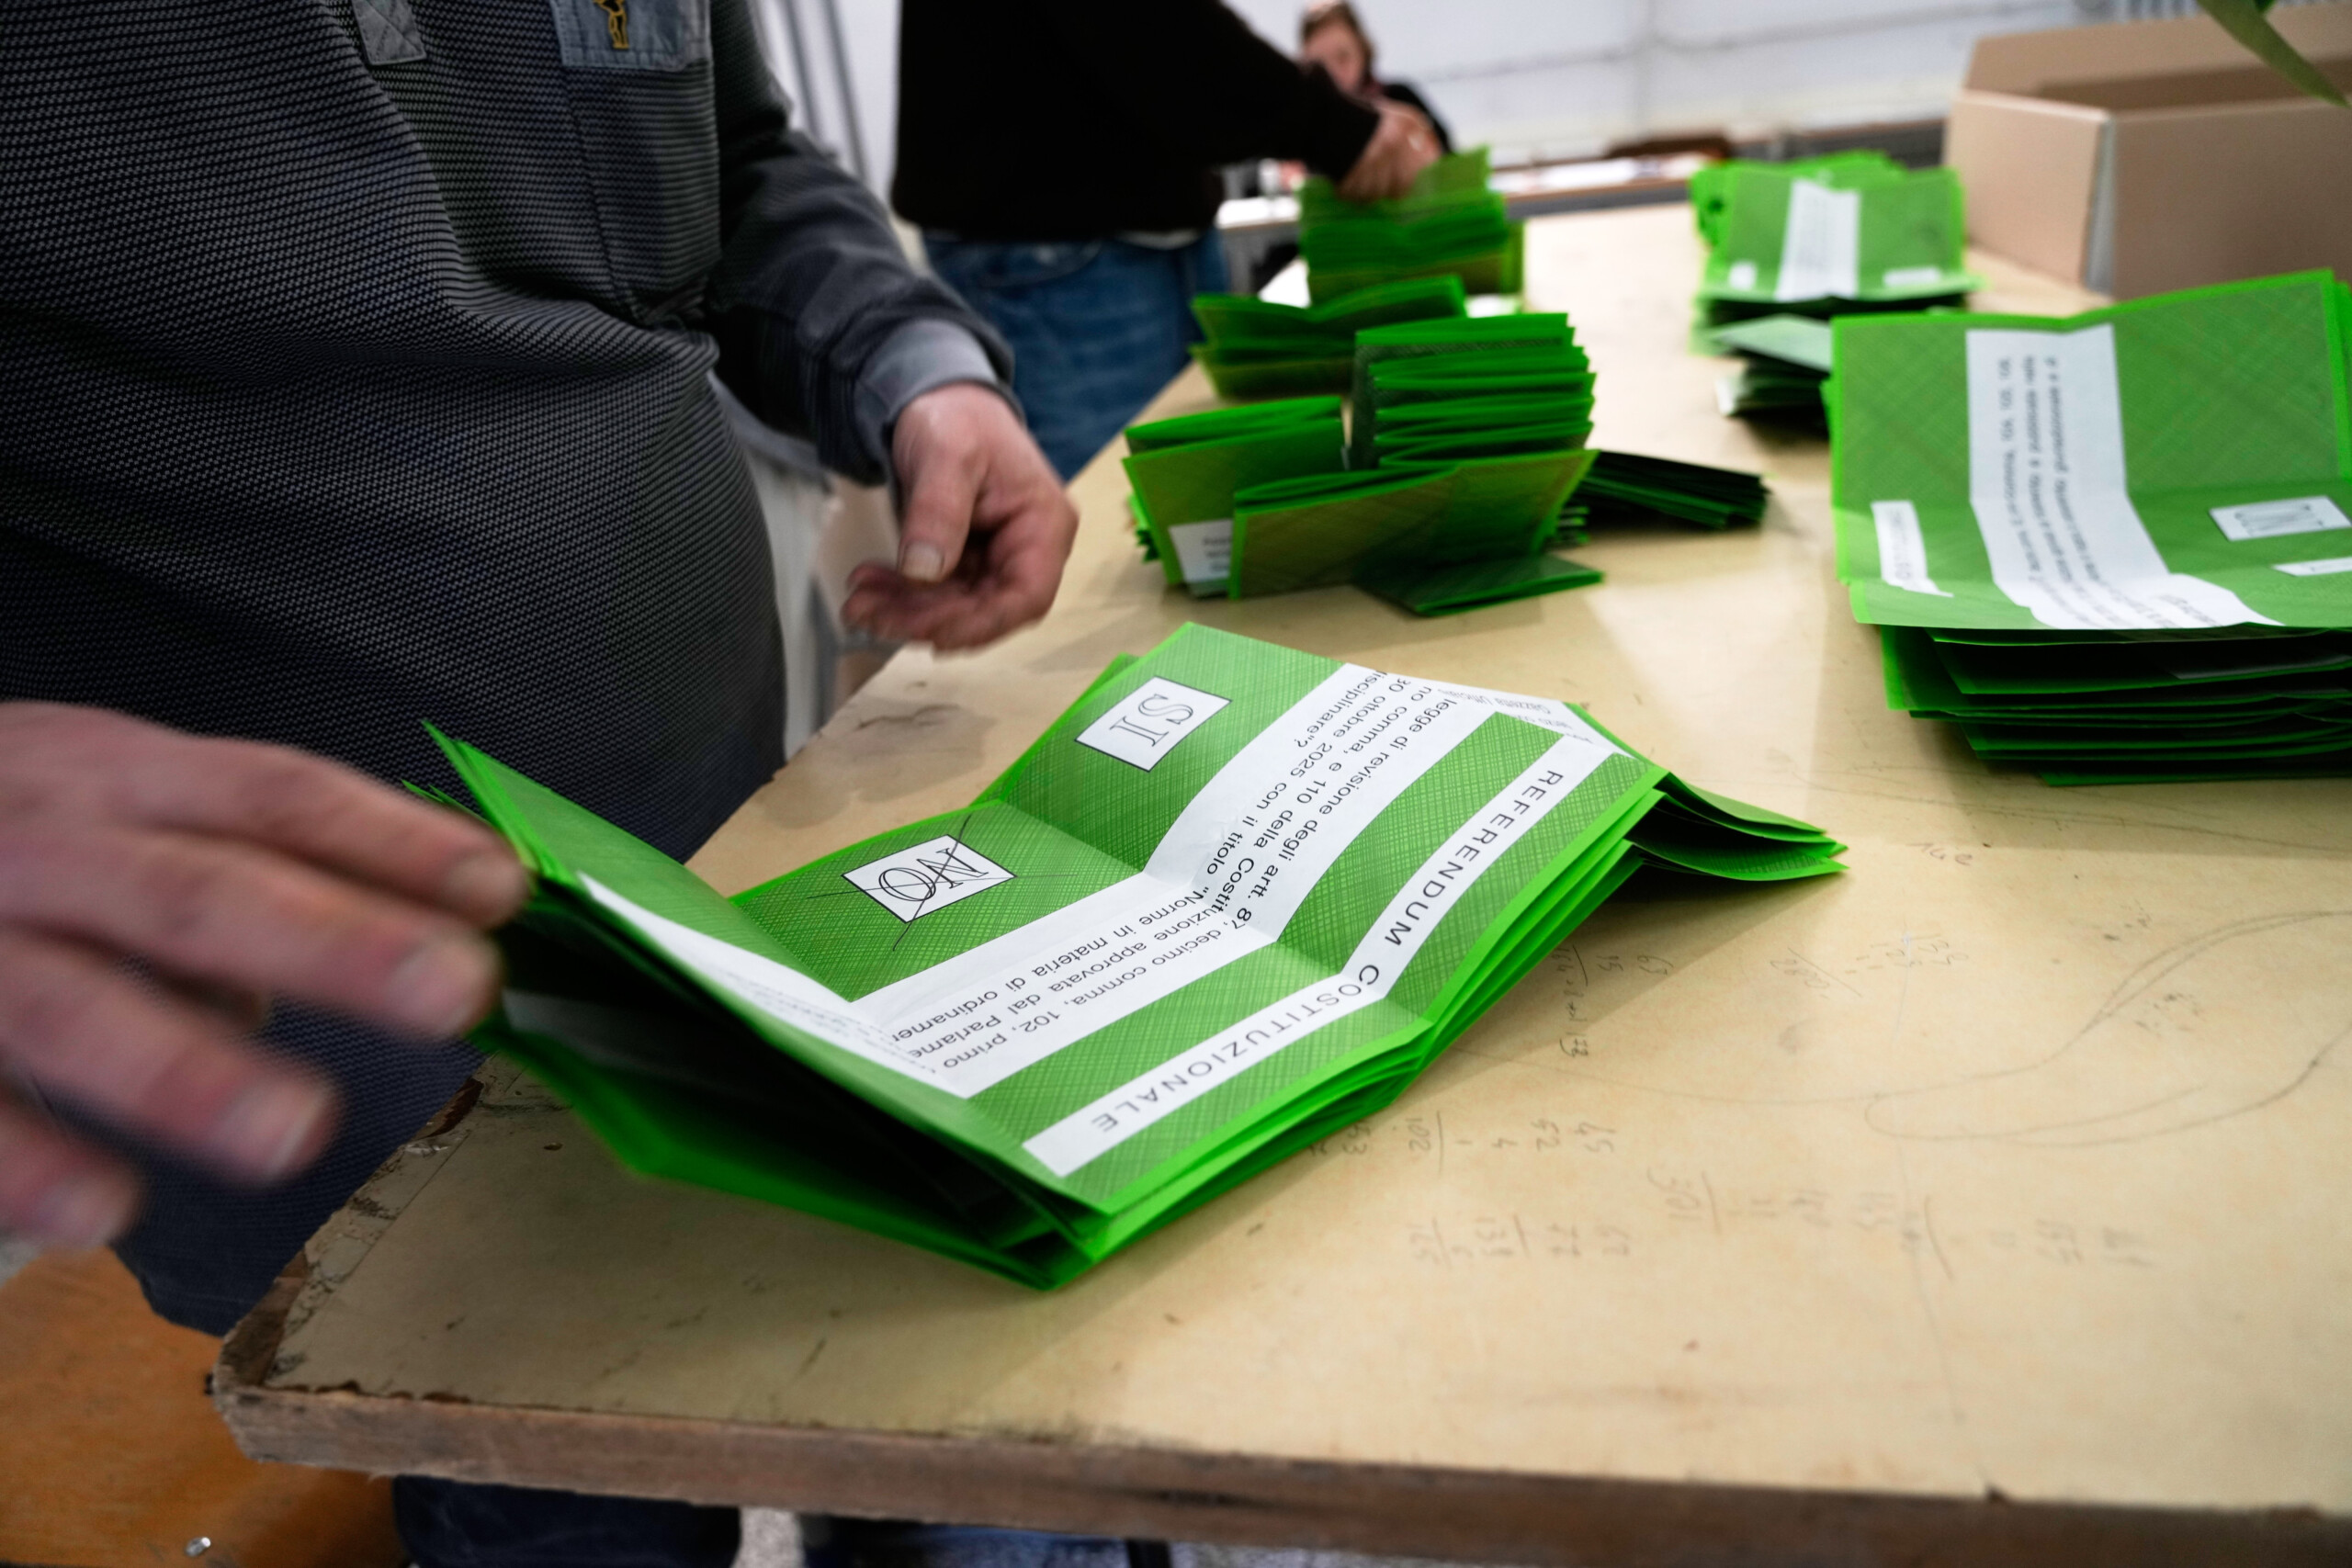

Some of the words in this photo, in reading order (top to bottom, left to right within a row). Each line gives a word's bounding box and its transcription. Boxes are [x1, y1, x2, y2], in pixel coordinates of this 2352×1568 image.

[1109, 694, 1193, 747] SI
[1333, 694, 1385, 738] ottobre
[1343, 705, 1408, 754] comma,
[1408, 698, 1458, 733] legge
[1290, 741, 1332, 778] 2025
[1389, 735, 1408, 750] di
[1319, 751, 1390, 816] revisione
[1329, 761, 1342, 772] e
[1256, 782, 1287, 810] con
[1296, 780, 1327, 805] 110
[1242, 815, 1258, 827] il
[1253, 809, 1294, 849] della
[1206, 831, 1243, 874] titolo
[1278, 819, 1318, 862] degli
[1384, 769, 1564, 947] REFERENDUM
[878, 847, 989, 902] NO
[1247, 864, 1279, 899] artt.
[1138, 886, 1209, 925] "Norme
[1154, 857, 1255, 941] Costituzione
[1114, 924, 1137, 938] in
[1223, 907, 1252, 931] 87,
[1032, 936, 1108, 977] materia
[1151, 929, 1222, 965] decimo
[1005, 976, 1026, 992] di
[1047, 942, 1148, 992] approvata
[1063, 965, 1148, 1006] comma,
[1007, 993, 1041, 1016] dal
[1012, 1010, 1061, 1033] 102,
[943, 1032, 1008, 1069] primo
[1091, 964, 1380, 1133] COSTITUZIONALE
